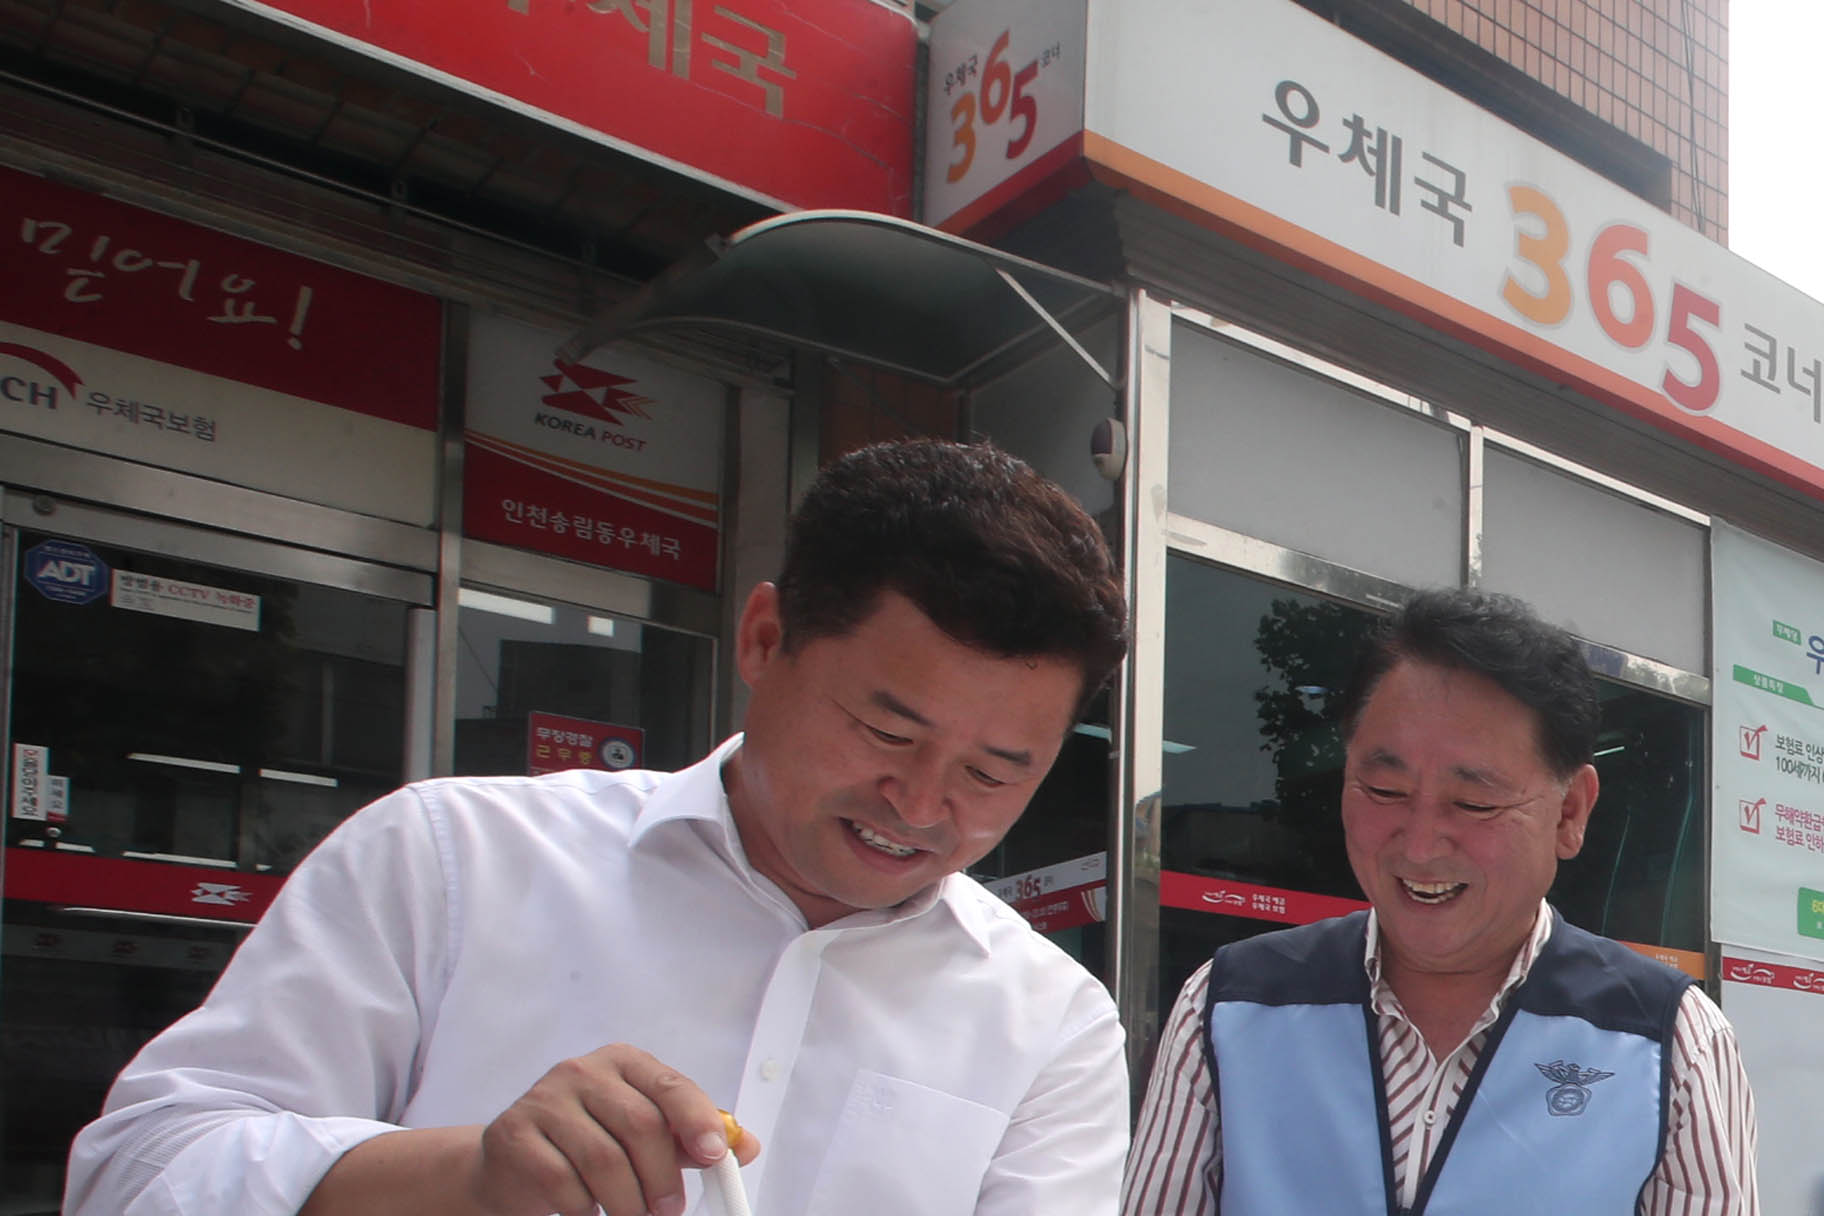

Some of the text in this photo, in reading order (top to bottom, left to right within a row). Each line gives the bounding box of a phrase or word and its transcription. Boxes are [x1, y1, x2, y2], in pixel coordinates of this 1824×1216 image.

[507, 0, 797, 120] 체국
[946, 29, 1039, 184] 365
[1261, 80, 1821, 424] 우체국 365 코너
[21, 217, 312, 350] 믿어요!
[86, 391, 216, 441] 우체국보험
[534, 412, 647, 451] KOREA POST
[501, 499, 681, 560] 인천송림동우체국
[37, 560, 97, 586] ADT
[167, 583, 209, 600] CCTV
[1776, 734, 1804, 755] 보험료
[1776, 756, 1820, 783] 100세까지
[1776, 826, 1804, 846] 보험료
[1806, 834, 1824, 853] 인하
[1016, 875, 1040, 899] 365
